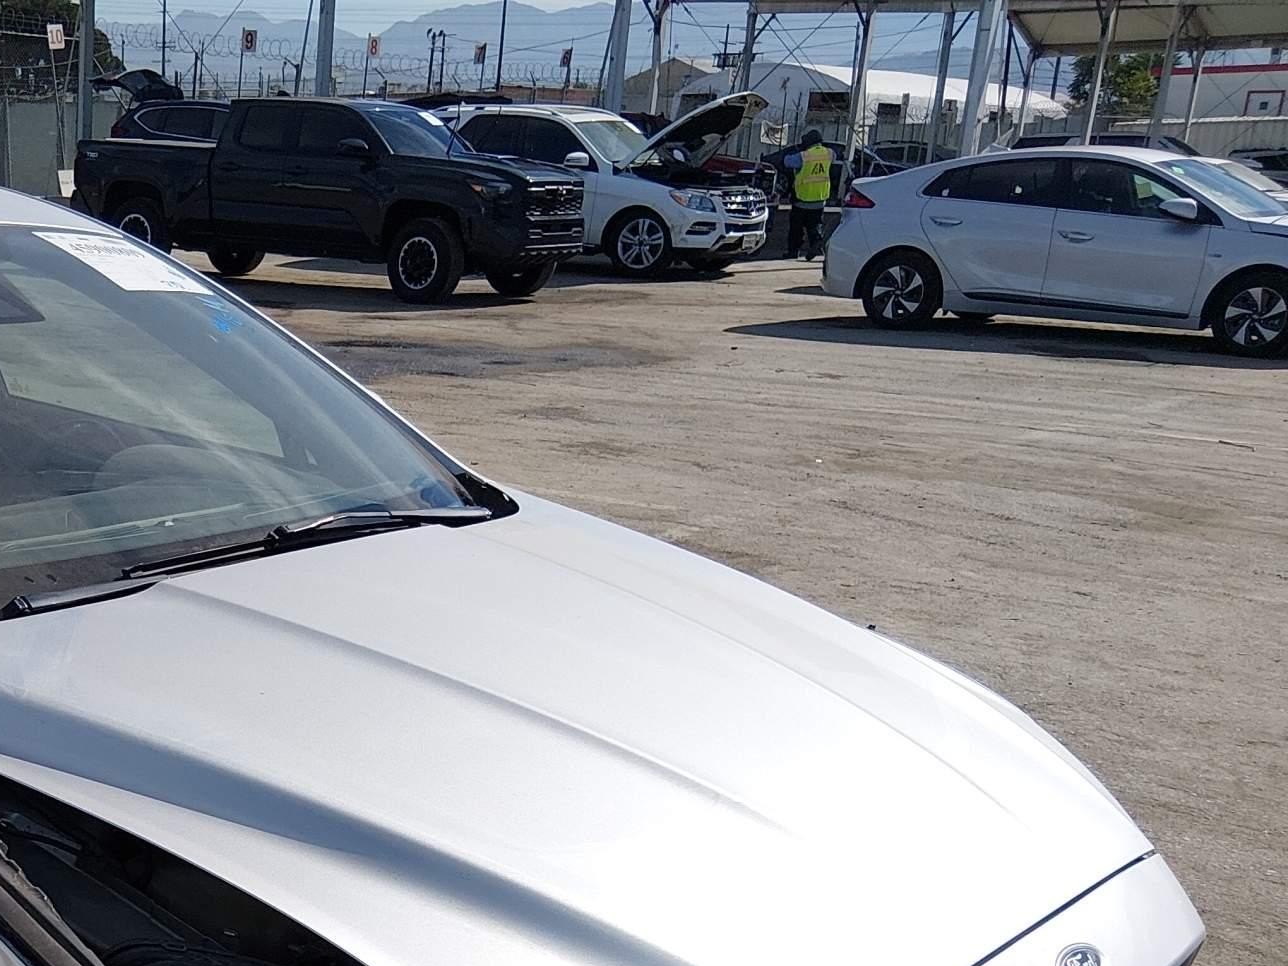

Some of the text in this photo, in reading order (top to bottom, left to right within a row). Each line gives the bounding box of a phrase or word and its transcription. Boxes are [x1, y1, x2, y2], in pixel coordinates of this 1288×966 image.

[48, 29, 64, 44] 10
[245, 32, 254, 50] 9
[370, 39, 378, 56] 8
